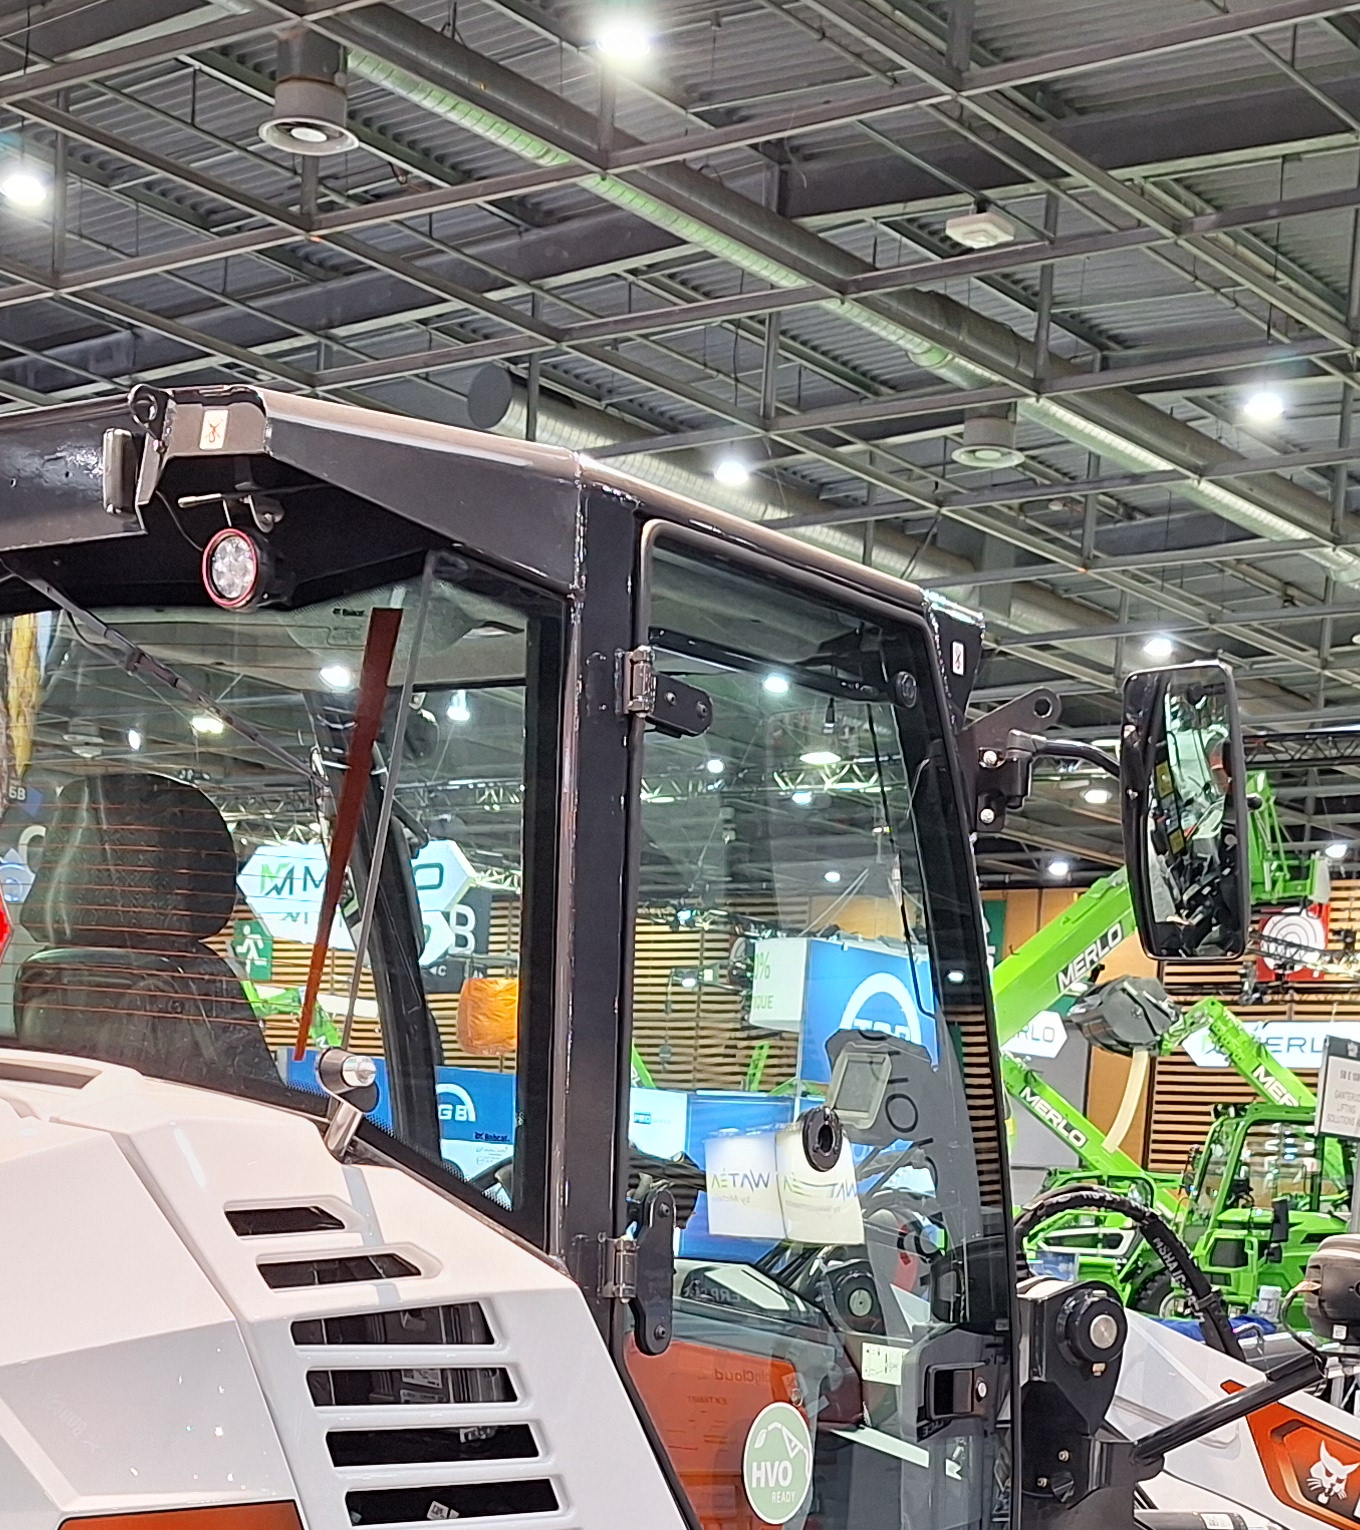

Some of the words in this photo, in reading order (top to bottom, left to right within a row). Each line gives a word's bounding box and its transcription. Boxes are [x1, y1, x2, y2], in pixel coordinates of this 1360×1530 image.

[1056, 921, 1124, 993] MERLO
[1015, 1025, 1056, 1043] RLO
[437, 1104, 469, 1121] GB
[1018, 1086, 1089, 1148] MERLO
[751, 1460, 792, 1488] HVO
[771, 1491, 796, 1503] READY
